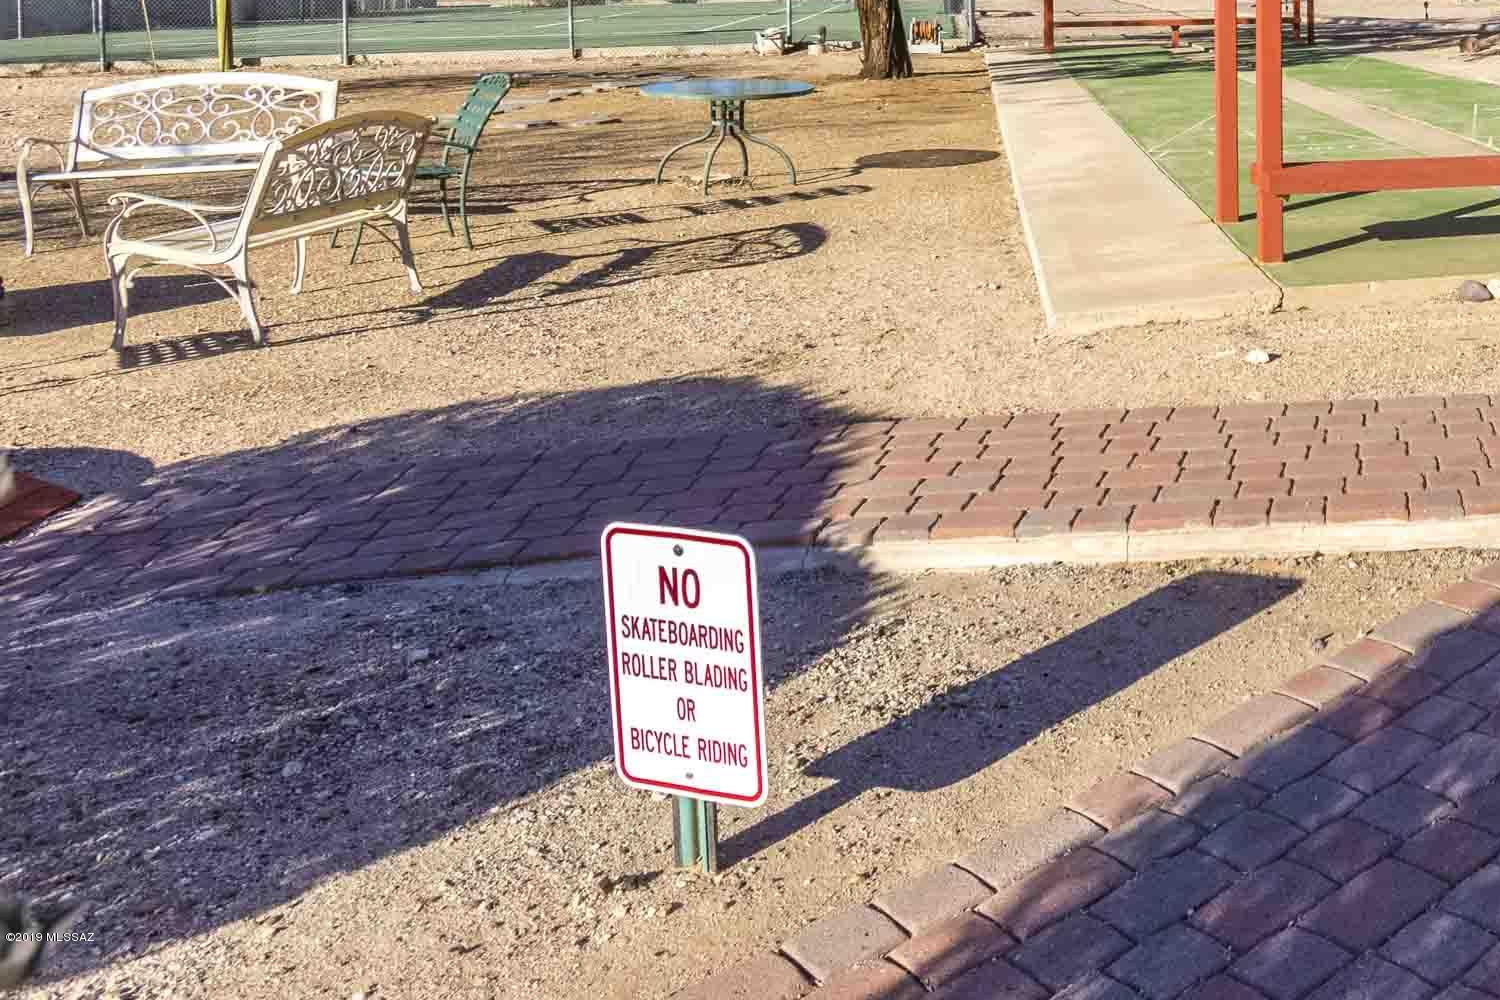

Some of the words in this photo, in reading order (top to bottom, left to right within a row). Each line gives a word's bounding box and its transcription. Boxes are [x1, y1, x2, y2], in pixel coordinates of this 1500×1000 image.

[658, 565, 701, 609] NO
[621, 614, 745, 654] SKATEBOARDING
[621, 652, 678, 683] ROLLER
[684, 661, 748, 692] BLADING
[676, 697, 697, 722] OR
[630, 727, 691, 759] BICYCLE
[697, 738, 748, 769] RIDING
